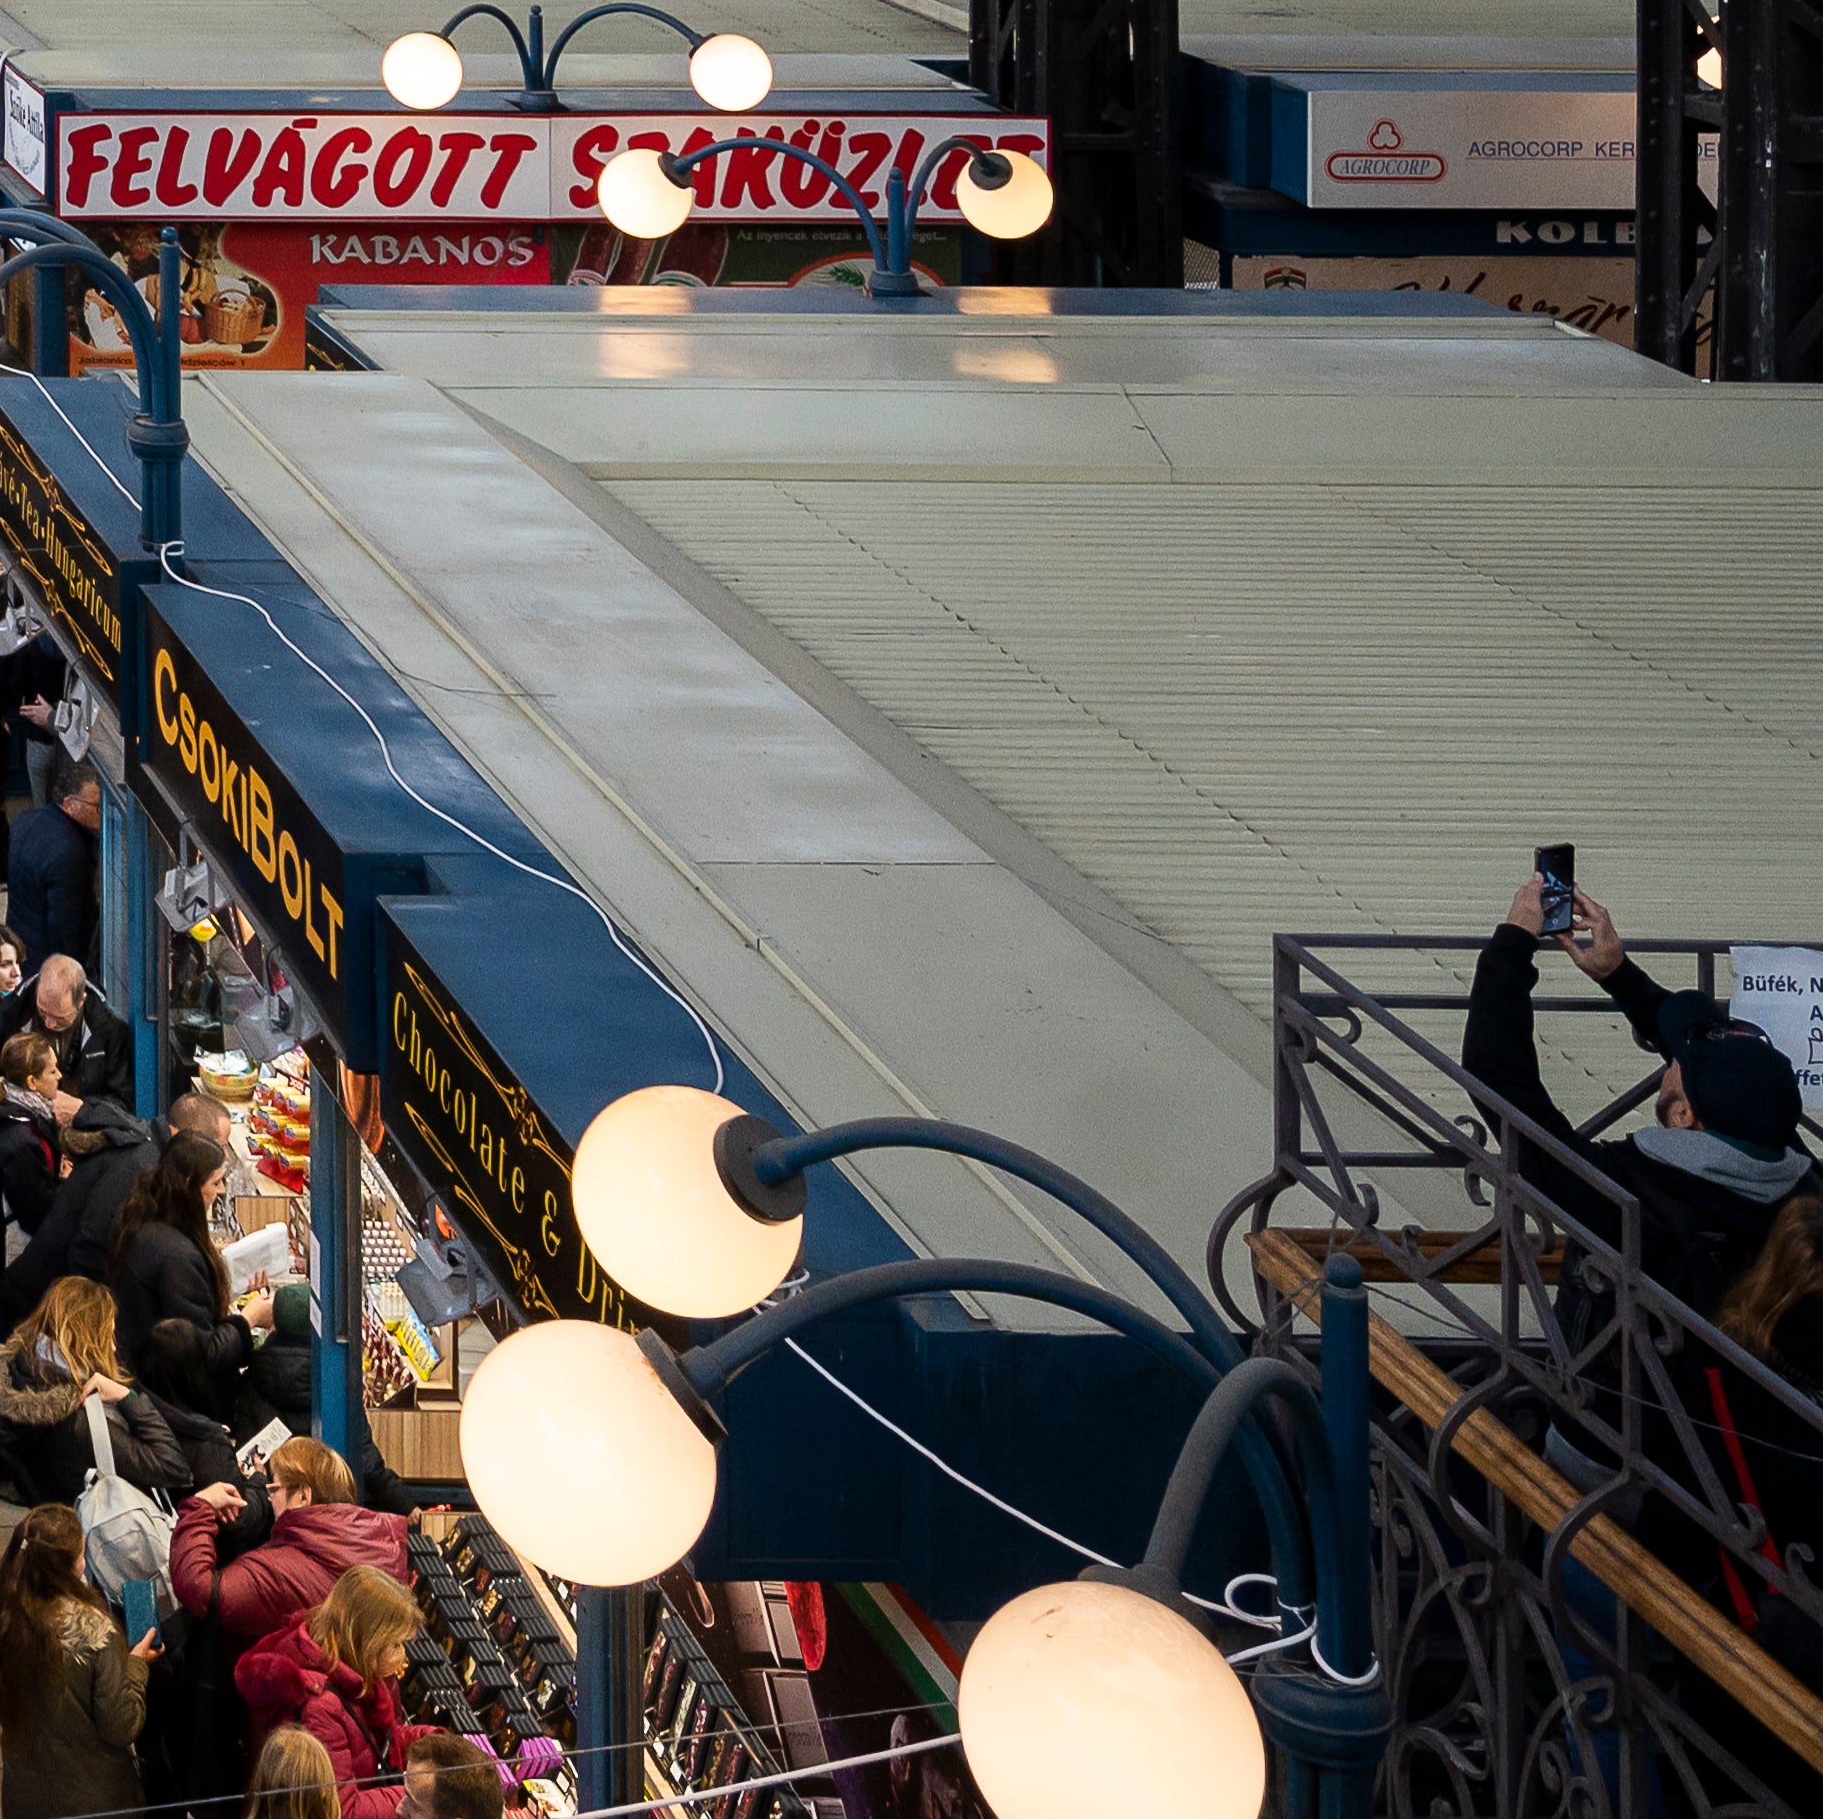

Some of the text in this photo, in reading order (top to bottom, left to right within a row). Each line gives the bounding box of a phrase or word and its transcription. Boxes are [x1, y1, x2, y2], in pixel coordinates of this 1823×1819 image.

[66, 118, 537, 209] FELVÁGOTT
[1468, 141, 1583, 158] AGROCORP
[1339, 159, 1431, 176] AGROCORP
[308, 232, 535, 267] KABANOS
[21, 482, 39, 541] Tea
[45, 515, 122, 655] Hungaricum
[1742, 975, 1804, 996] Büfék,
[394, 991, 525, 1214] Chocolate
[541, 1190, 562, 1258] &
